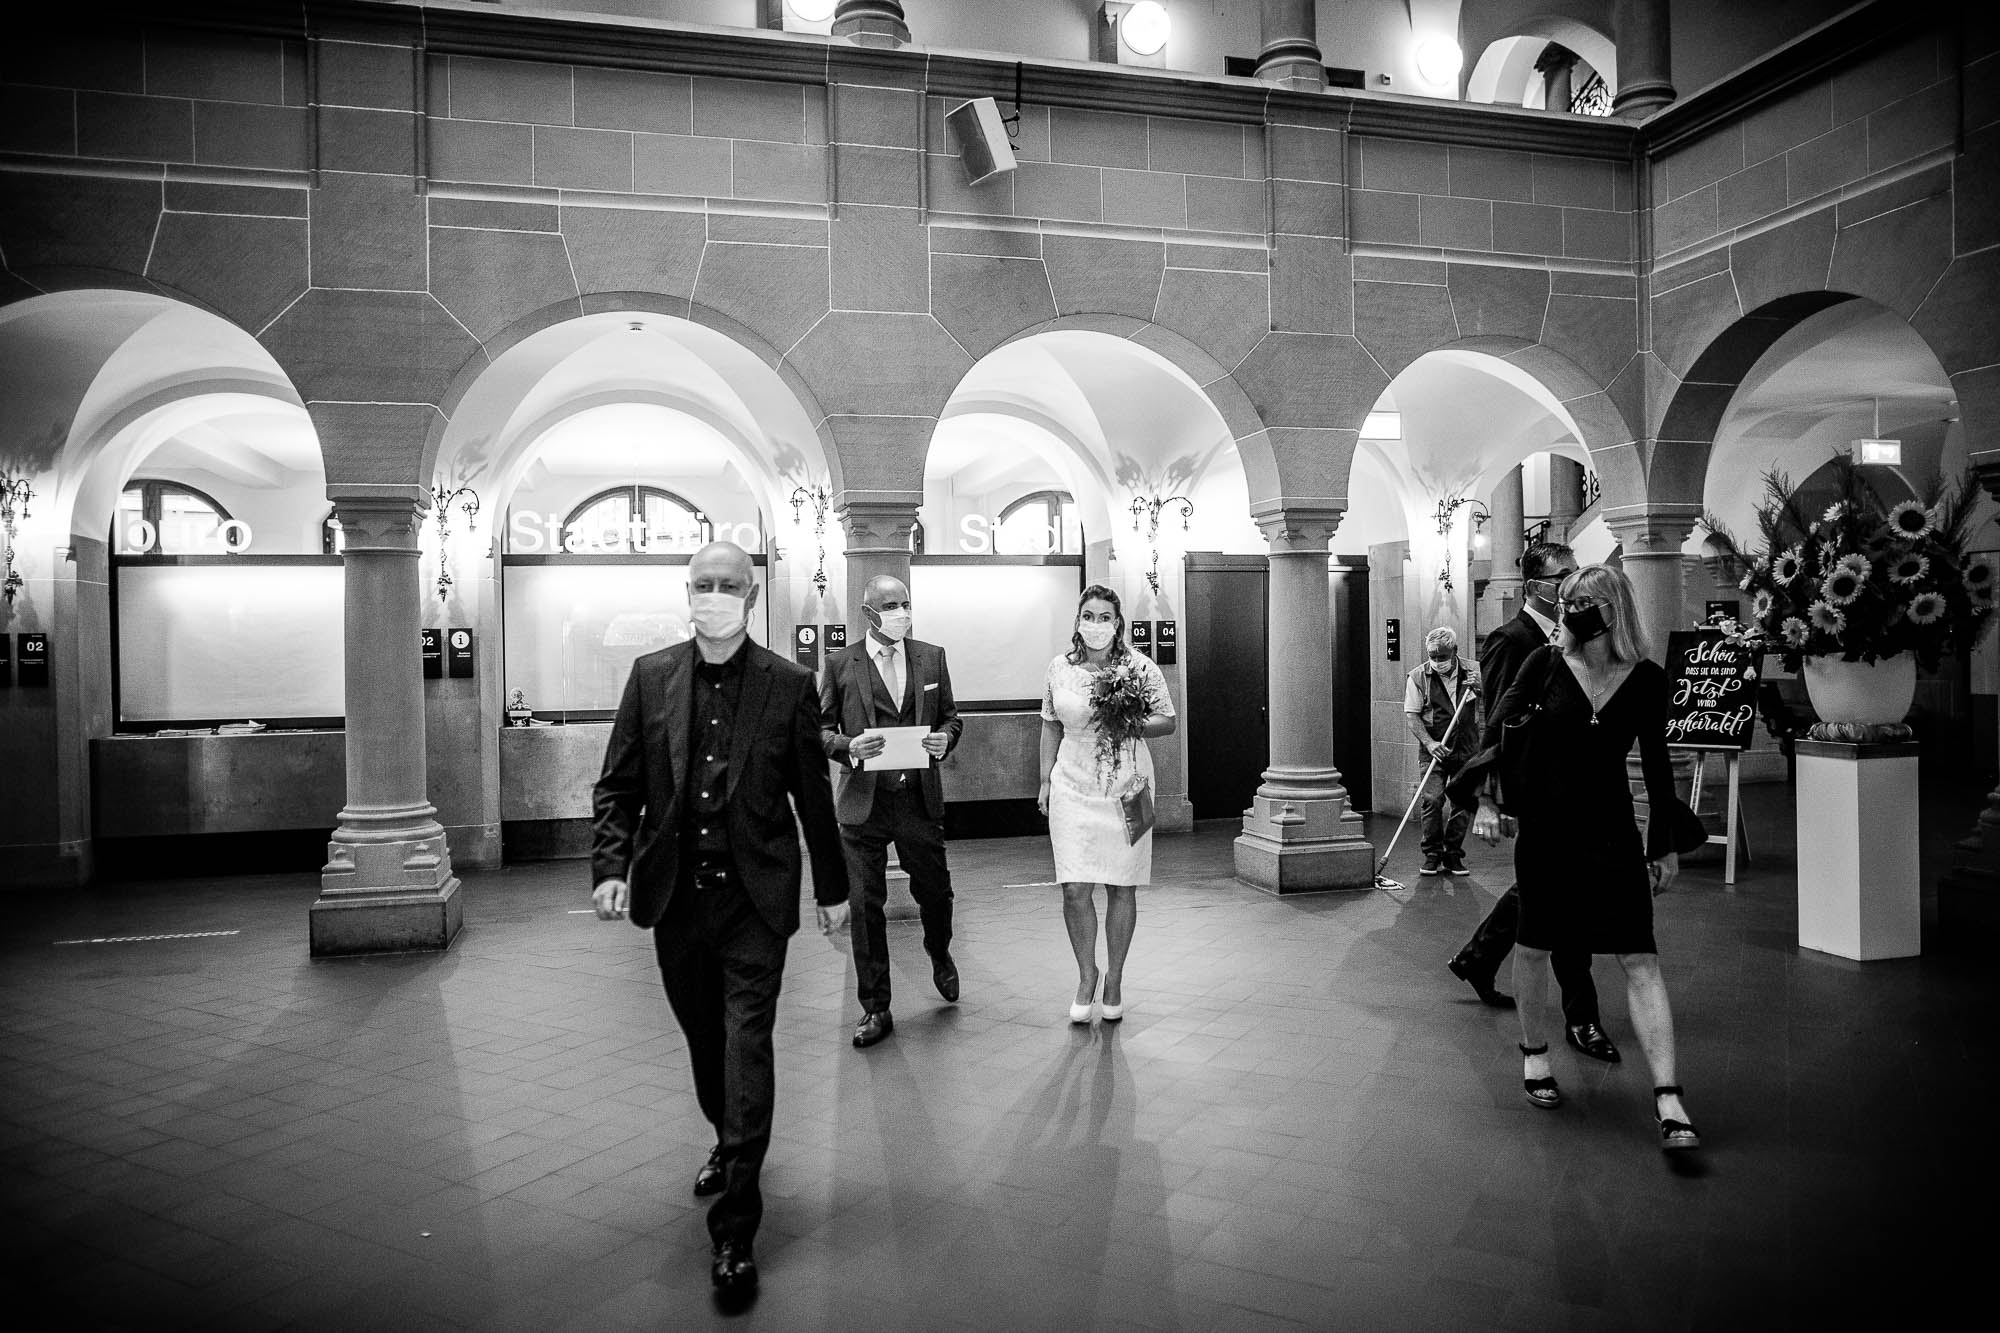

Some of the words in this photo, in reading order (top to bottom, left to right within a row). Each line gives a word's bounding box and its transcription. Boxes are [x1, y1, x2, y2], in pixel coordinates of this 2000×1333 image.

[831, 631, 845, 641] 03
[1133, 627, 1146, 636] 03
[1162, 627, 1175, 636] 04
[26, 641, 44, 652] 02
[1720, 667, 1737, 676] SIND
[1673, 678, 1741, 706] Jetzt
[1697, 699, 1717, 707] WIRD
[1665, 705, 1753, 741] geheiratet!
